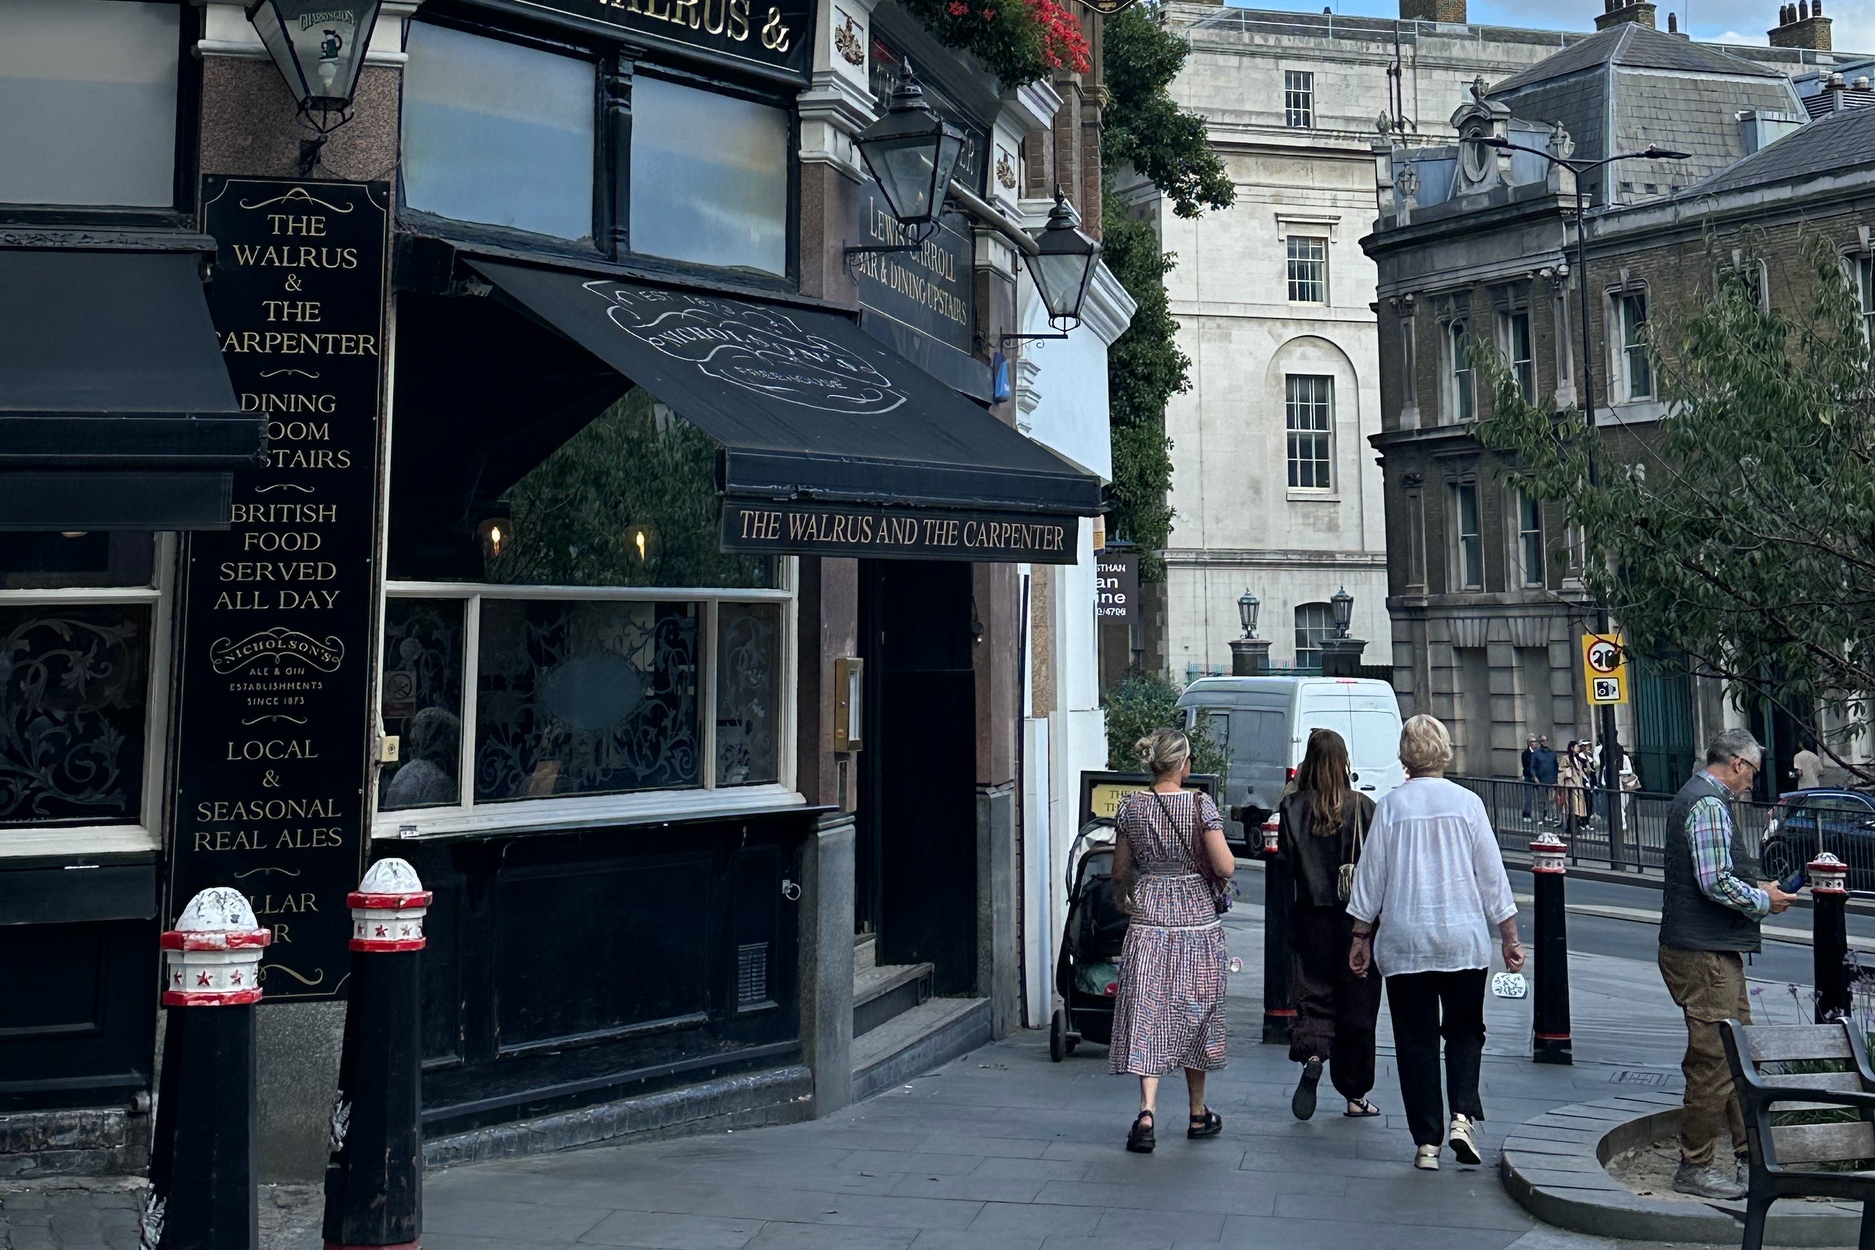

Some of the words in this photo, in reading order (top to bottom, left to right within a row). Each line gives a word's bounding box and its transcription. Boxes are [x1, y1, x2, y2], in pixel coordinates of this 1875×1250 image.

[761, 5, 790, 52] &
[267, 214, 326, 236] THE
[869, 196, 905, 253] LEWIS
[233, 244, 357, 269] WALRUS
[284, 273, 302, 292] &
[880, 256, 888, 285] &
[891, 261, 926, 305] DINING
[928, 282, 967, 326] UPSTAIRS
[262, 301, 321, 322] THE
[216, 331, 378, 356] ARPENTER
[240, 393, 336, 413] DINING
[267, 421, 329, 441] OOM
[264, 450, 351, 469] STAIRS
[230, 504, 337, 523] BRITISH
[739, 509, 782, 540] THE
[788, 513, 873, 544] WALRUS
[876, 517, 918, 546] AND
[923, 519, 959, 546] THE
[963, 521, 1065, 551] CARPENTER
[244, 532, 321, 551] FOOD
[219, 562, 337, 582] SERVED
[213, 591, 269, 610] ALL
[278, 590, 340, 610] DAY
[224, 639, 332, 664] NICHOLSON'S
[250, 667, 269, 676] ALE
[274, 667, 280, 676] &
[285, 667, 305, 676] GIN
[229, 681, 323, 691] ESTABLISHMENTS
[247, 697, 279, 706] SINCE
[226, 740, 319, 762] LOCAL
[262, 769, 281, 788] &
[196, 798, 342, 823] SEASONAL
[193, 829, 268, 852] REAL
[275, 827, 342, 849] ALES
[250, 893, 319, 915] LLAR
